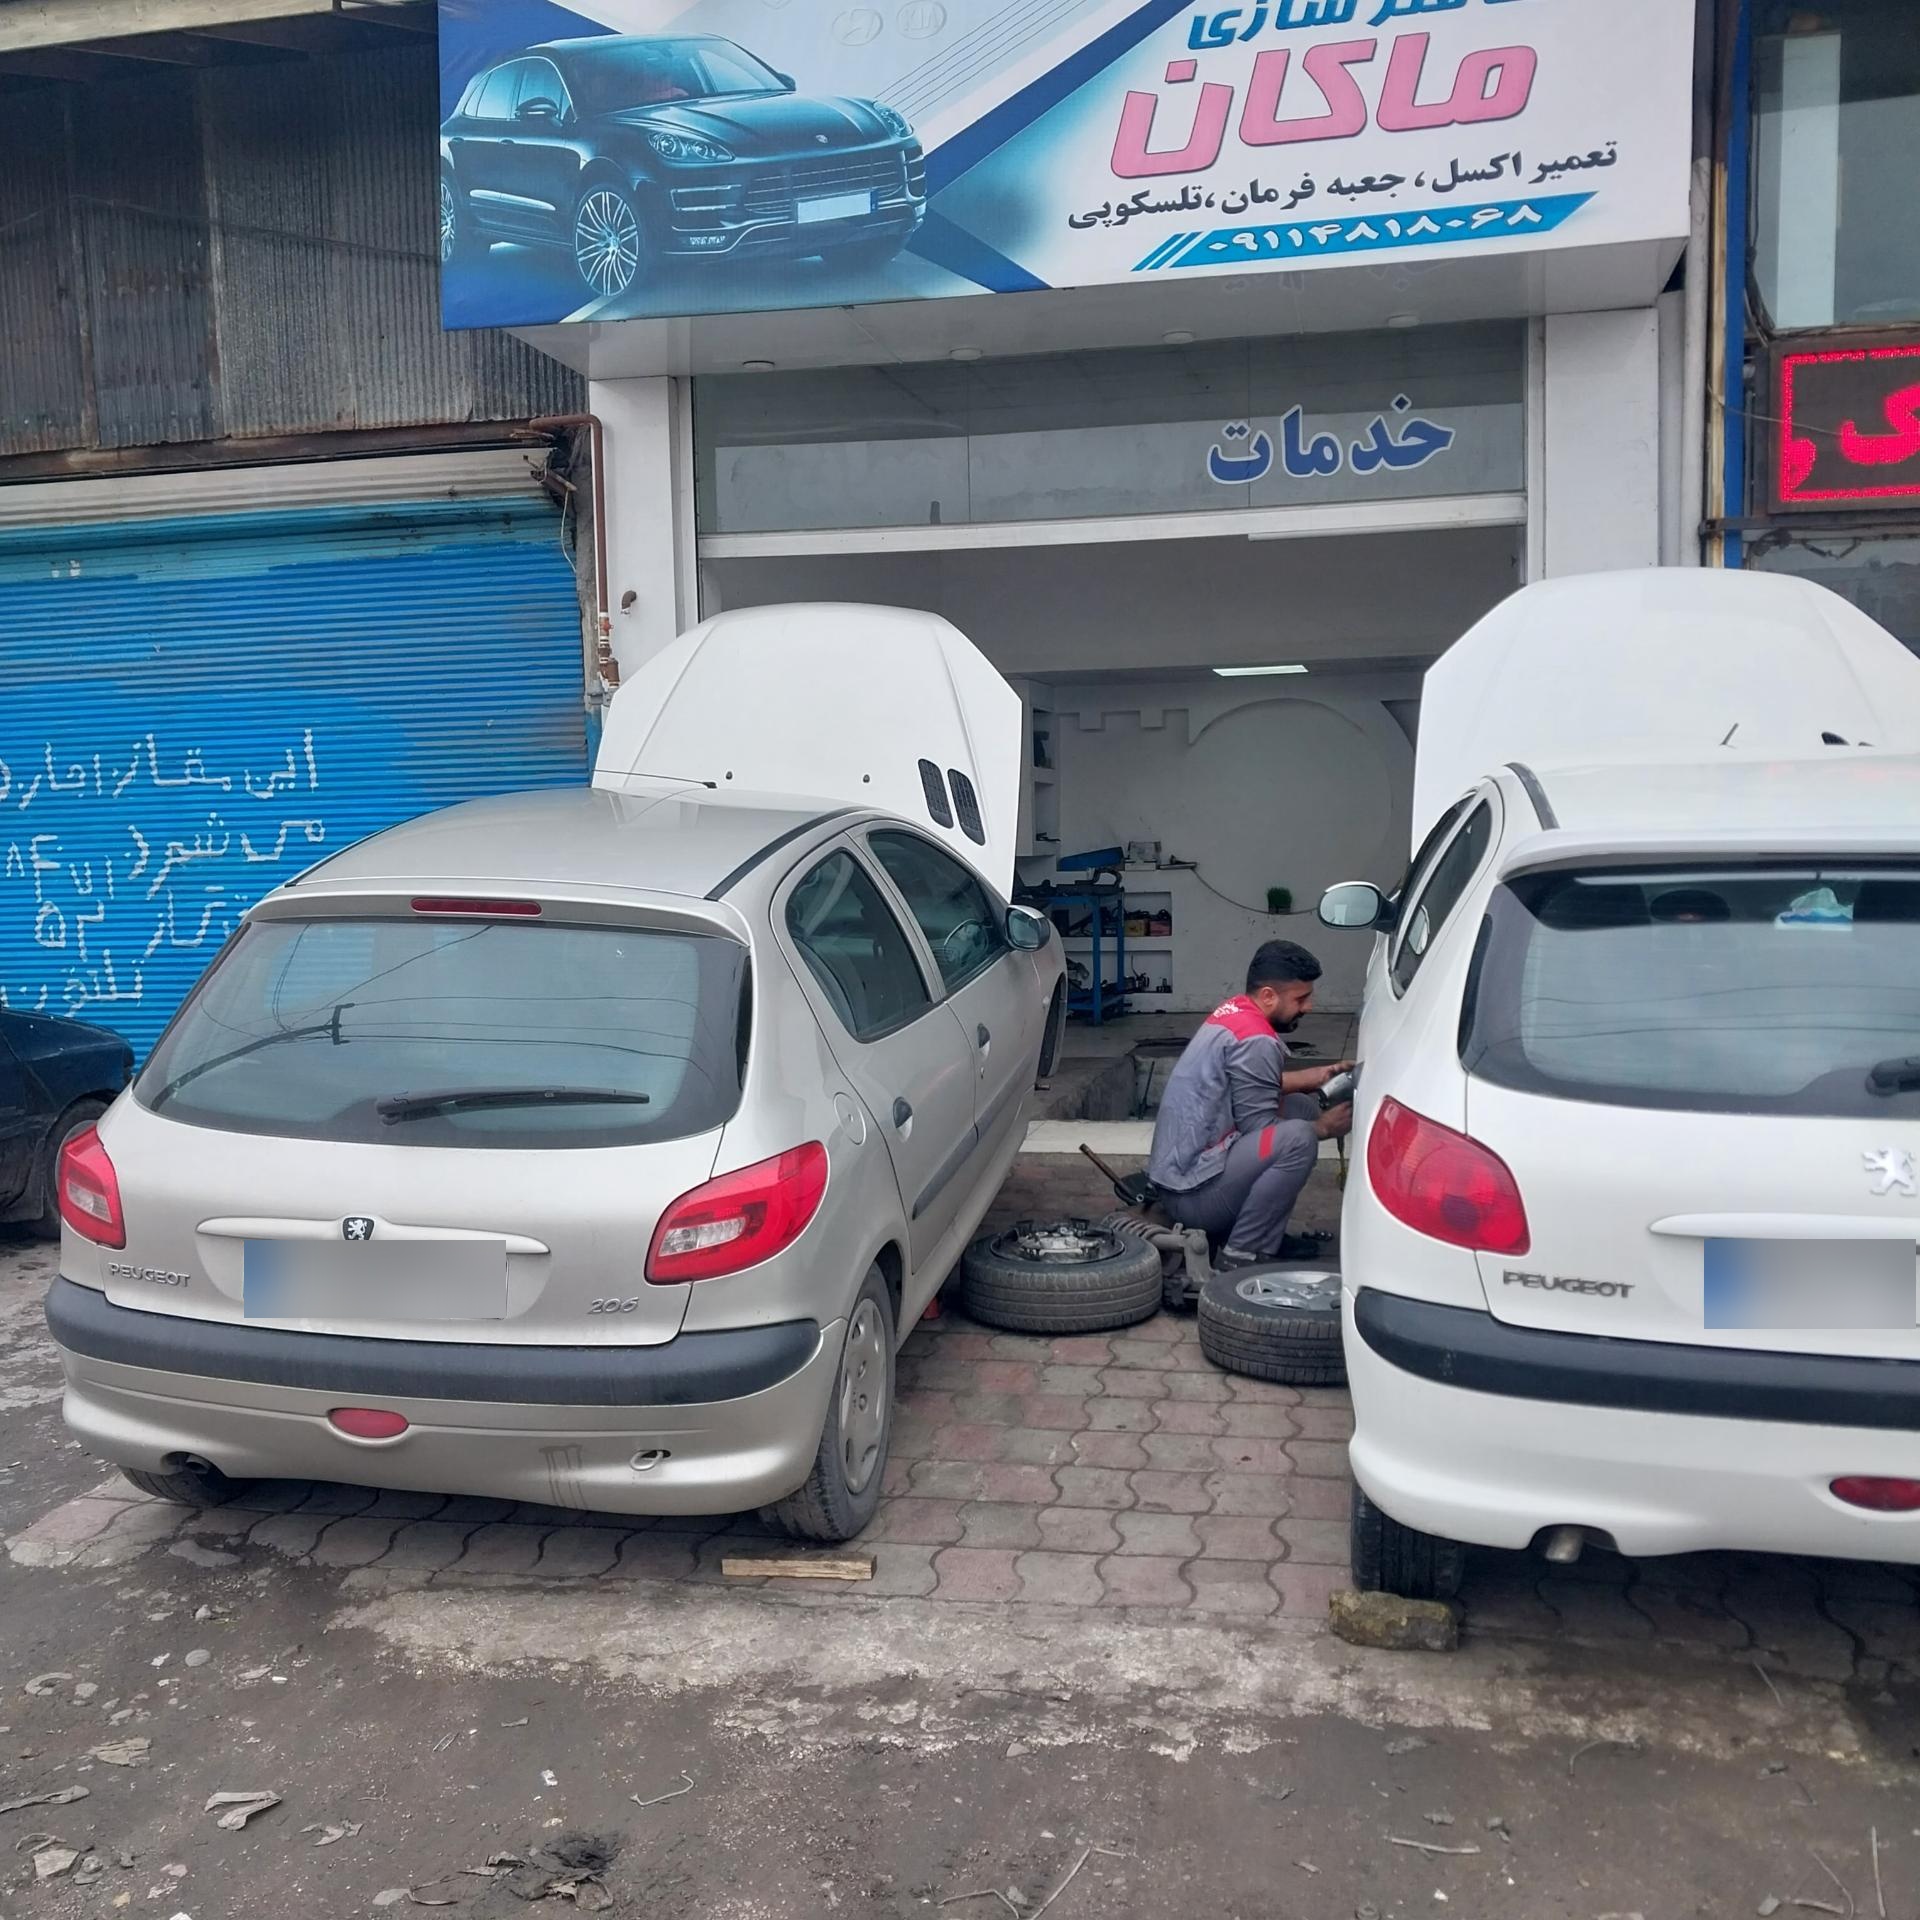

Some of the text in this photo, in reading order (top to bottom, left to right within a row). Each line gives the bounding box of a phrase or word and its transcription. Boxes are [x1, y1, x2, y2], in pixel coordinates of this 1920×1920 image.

[1110, 32, 1538, 180] ماکان
[1528, 141, 1618, 184] تعمیر
[1068, 185, 1203, 229] تلسکوپی
[1326, 171, 1406, 201] جعبه
[1208, 204, 1543, 251] ۰۹۱۱۴۸۱۸۰۶۸
[1206, 393, 1456, 485] خدمات
[108, 1262, 191, 1287] PEUGEOT
[1503, 1269, 1635, 1298] PEUGEOT
[587, 1296, 640, 1316] 206
